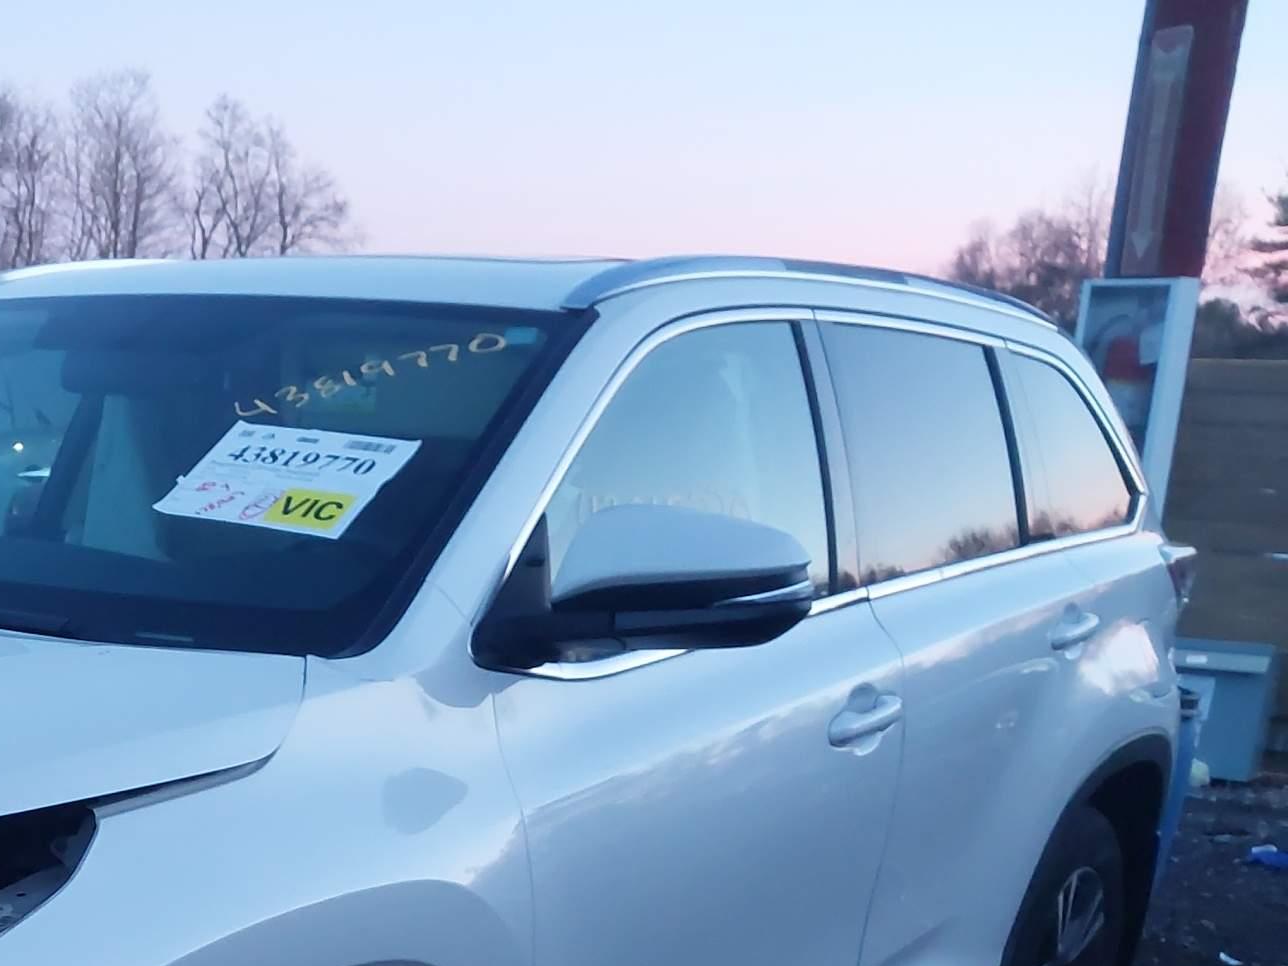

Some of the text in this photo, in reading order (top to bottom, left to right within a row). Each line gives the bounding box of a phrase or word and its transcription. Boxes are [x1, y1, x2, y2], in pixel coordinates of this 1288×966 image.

[234, 332, 508, 418] 43819770
[228, 443, 377, 476] 43819770
[282, 495, 344, 521] VIC
